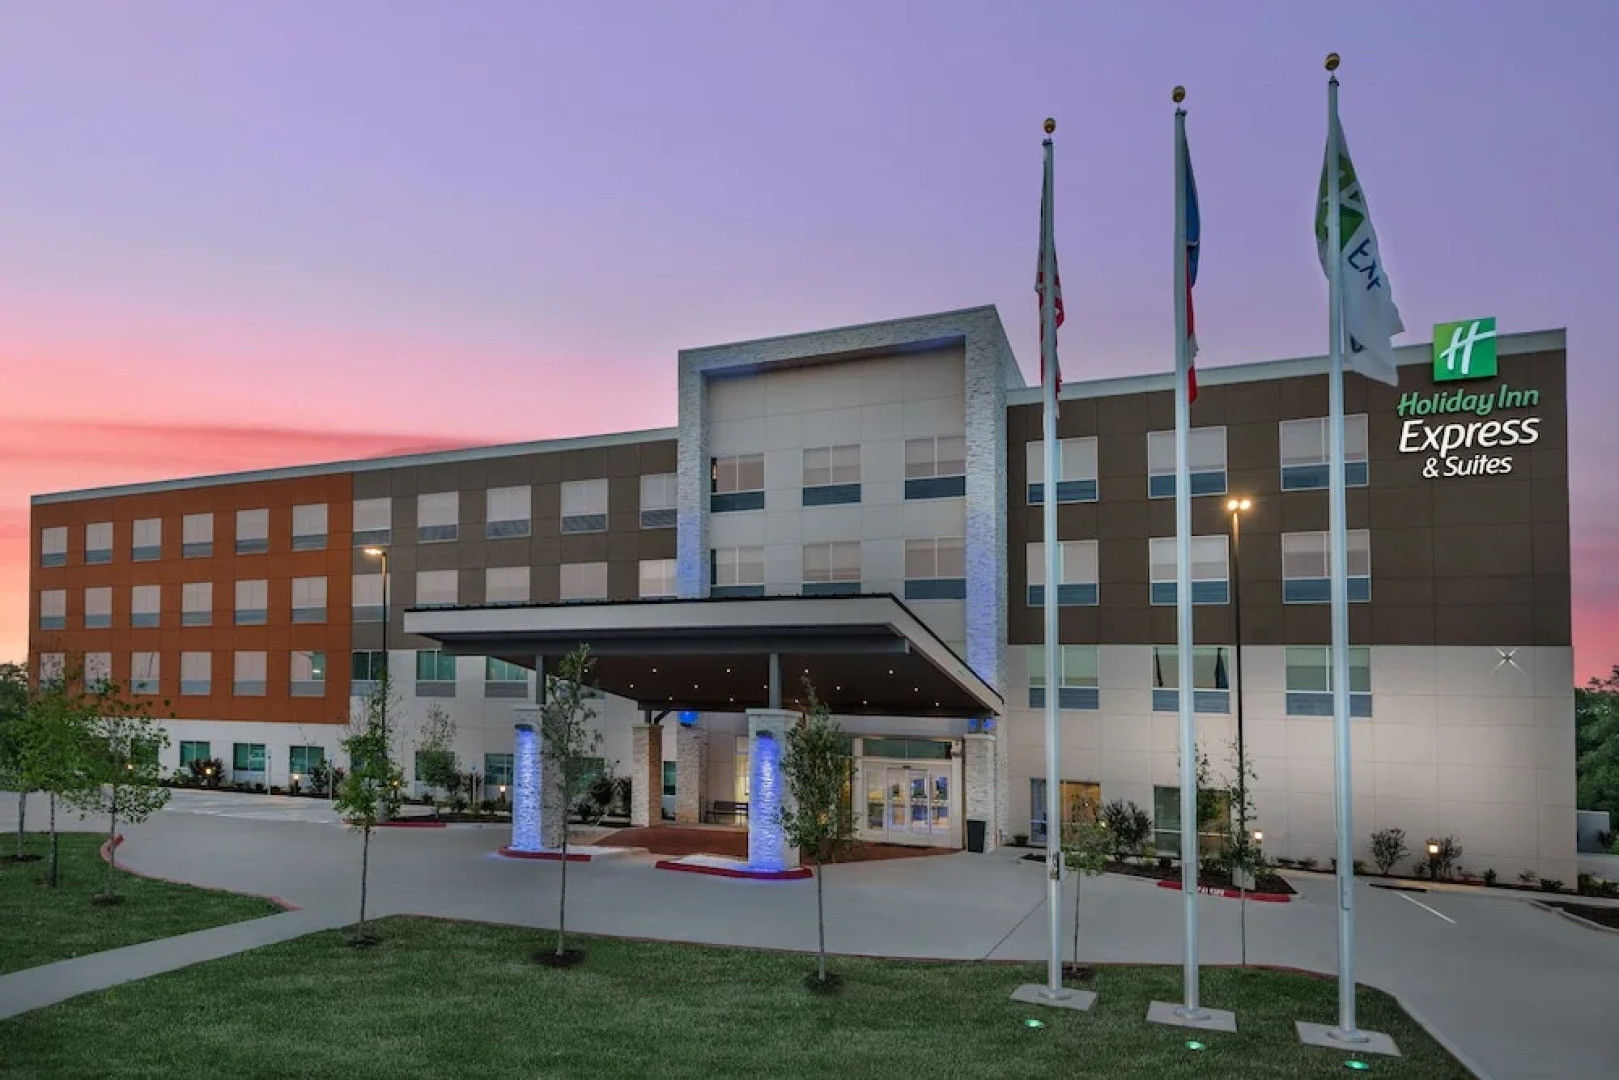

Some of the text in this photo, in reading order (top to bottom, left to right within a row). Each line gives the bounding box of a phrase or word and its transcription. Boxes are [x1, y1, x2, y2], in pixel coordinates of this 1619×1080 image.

[1397, 384, 1539, 416] Holiday Inn
[1399, 417, 1542, 458] Express
[1422, 454, 1513, 478] & Suites
